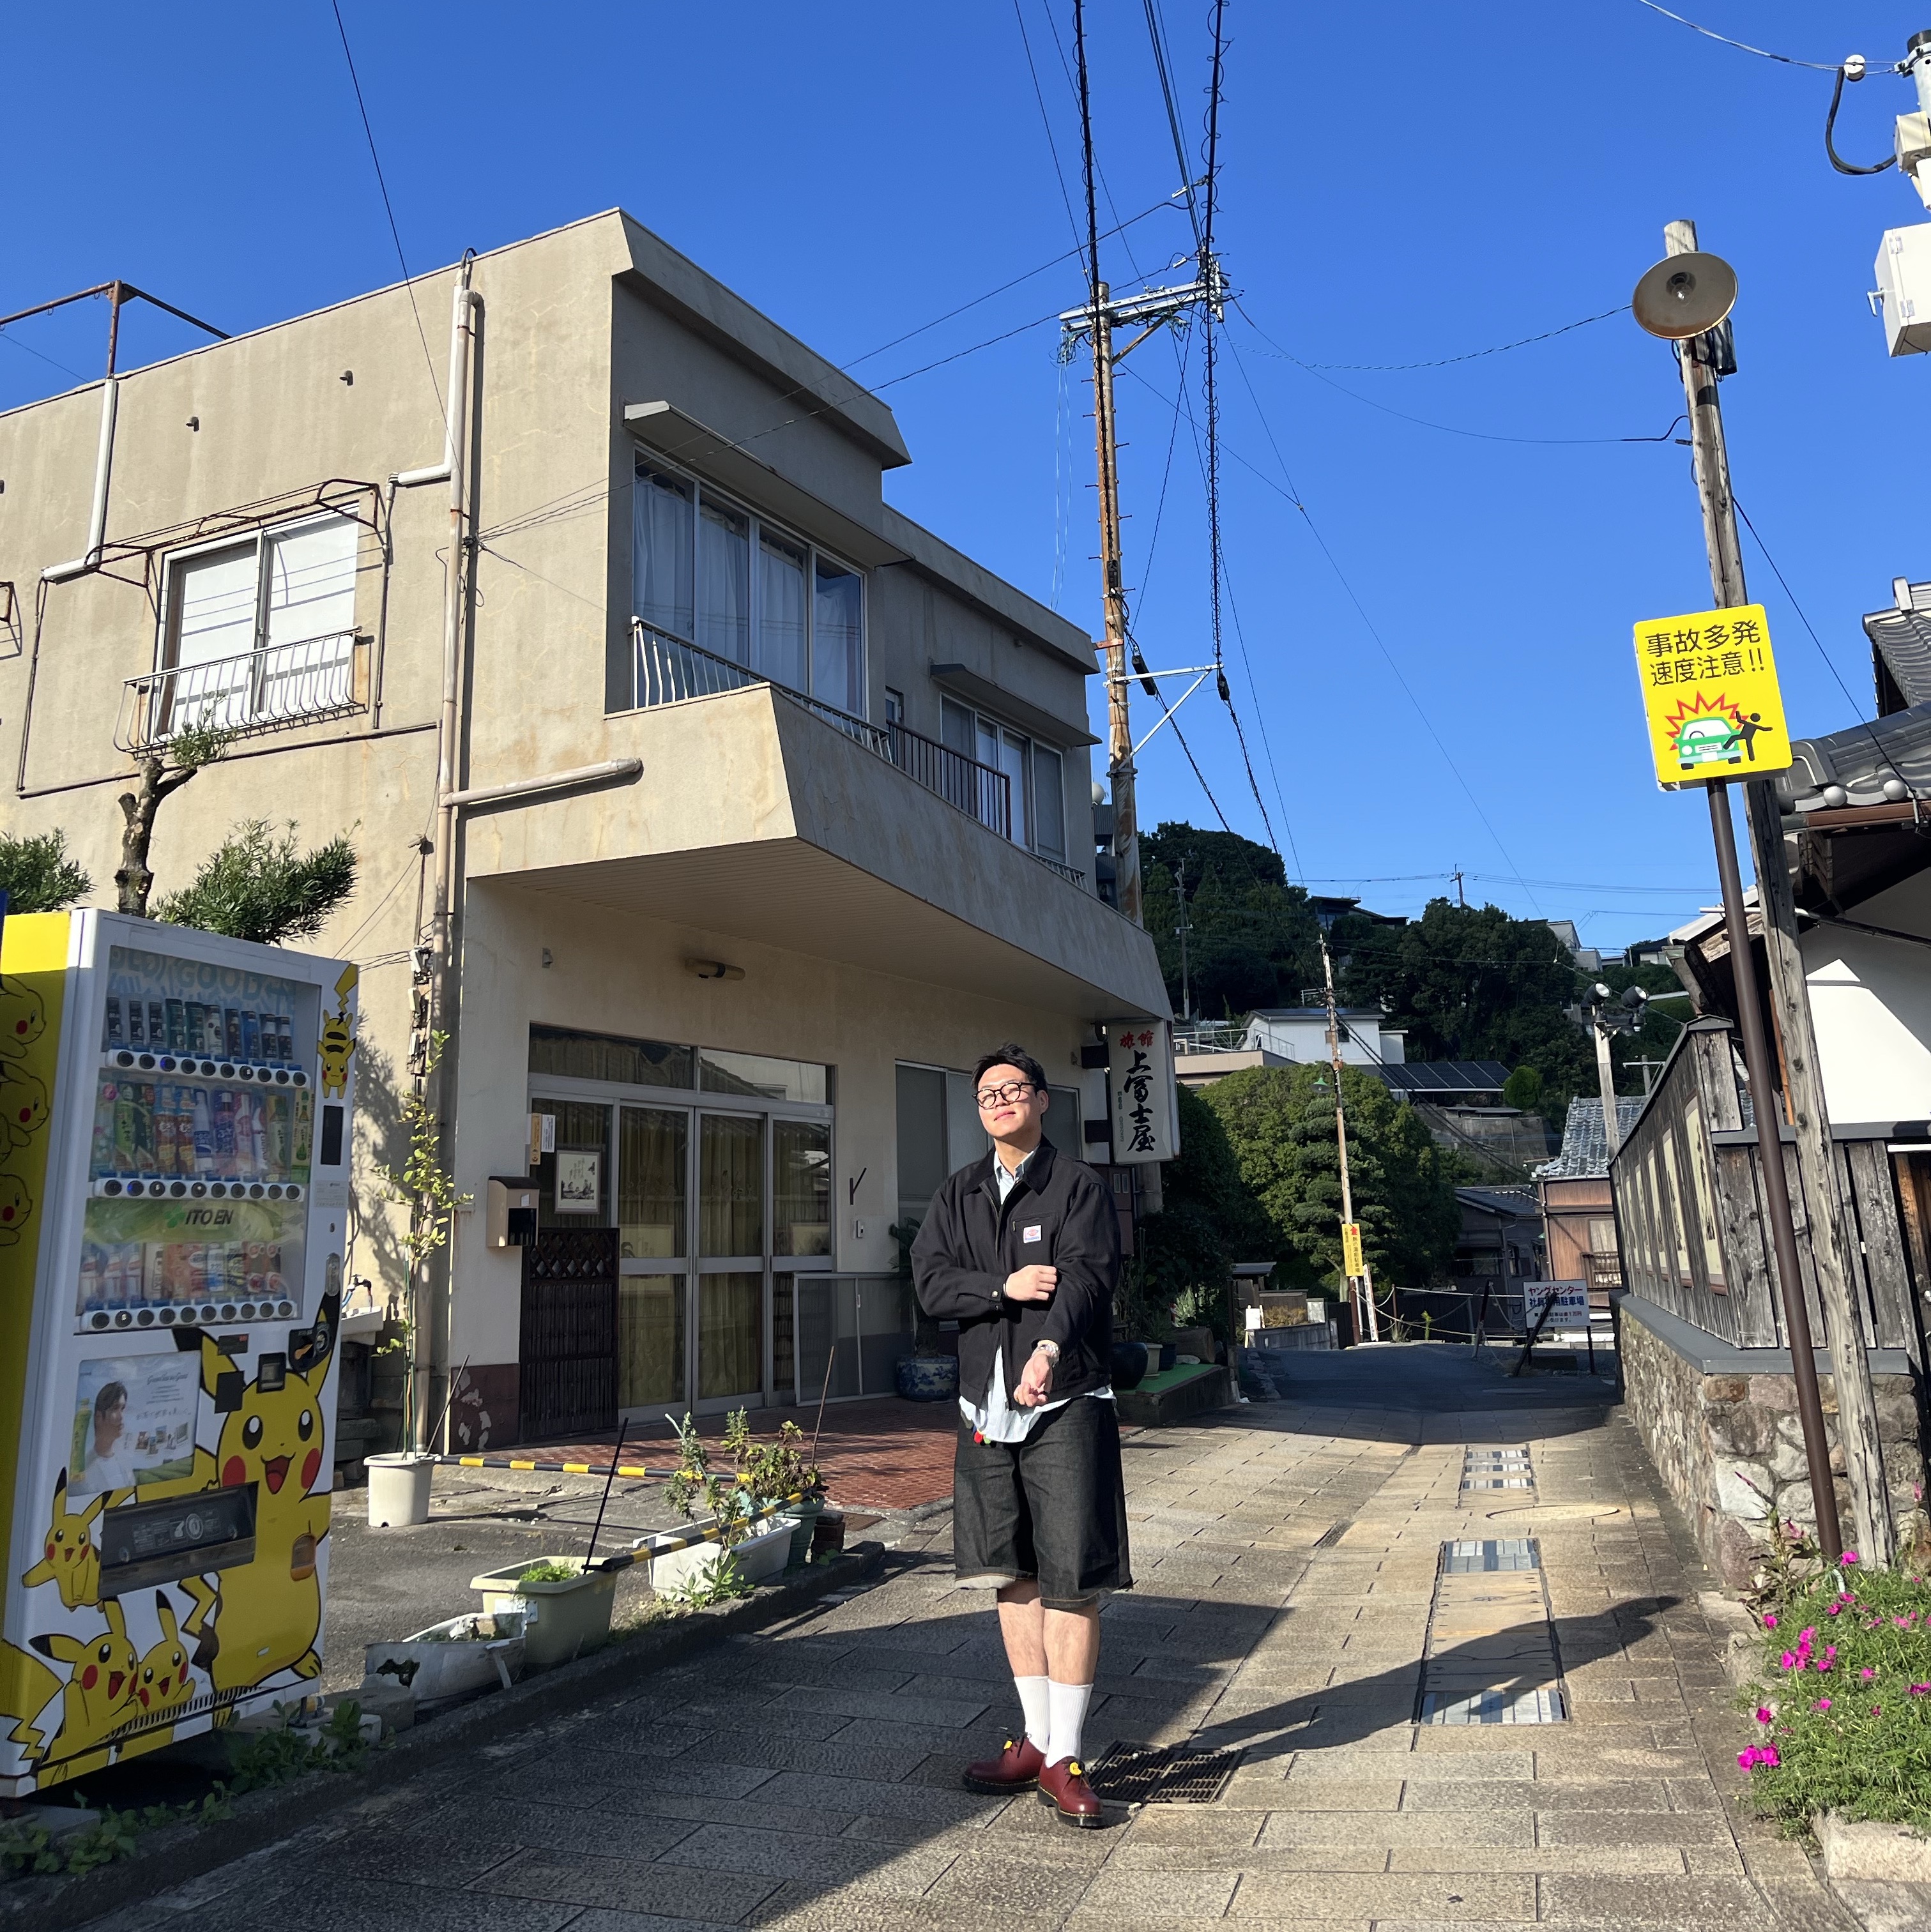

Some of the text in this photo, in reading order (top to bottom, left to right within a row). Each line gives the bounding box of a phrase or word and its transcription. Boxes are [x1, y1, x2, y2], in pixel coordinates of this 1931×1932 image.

[1645, 619, 1761, 658] 事故多発
[1119, 1030, 1154, 1049] 旅館
[1123, 1049, 1156, 1152] 上富士屋
[185, 1209, 234, 1225] ITO EN
[1528, 1285, 1584, 1296] ヤングセンター
